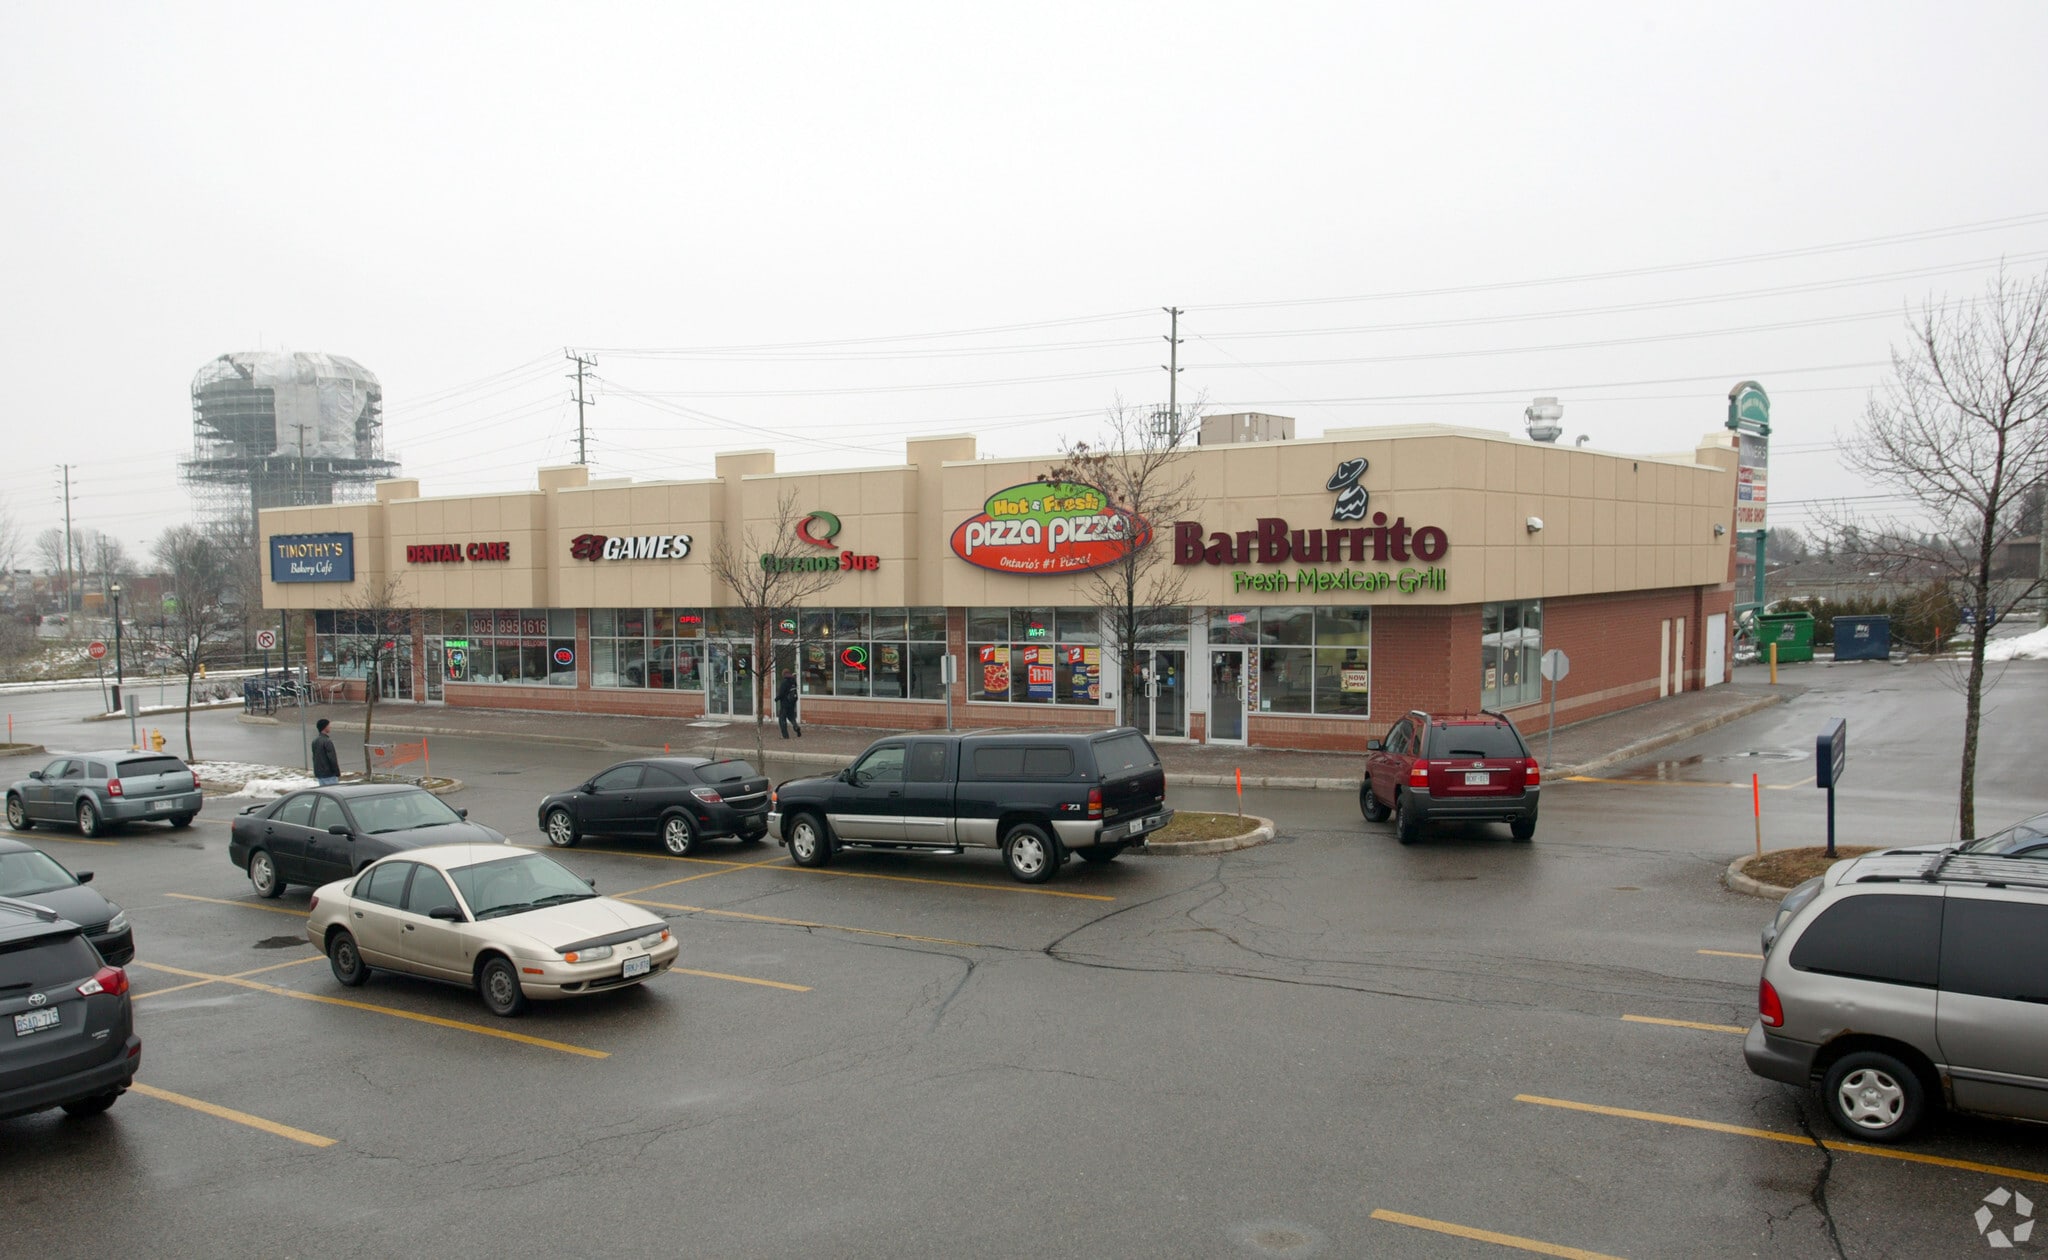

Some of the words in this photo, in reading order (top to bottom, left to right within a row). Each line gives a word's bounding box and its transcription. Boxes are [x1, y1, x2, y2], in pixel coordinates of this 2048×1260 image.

[994, 499, 1030, 516] Hot
[1031, 501, 1041, 511] &
[1042, 492, 1099, 513] Fresh
[1172, 511, 1449, 565] BarBurrito
[278, 543, 343, 558] TIMOTHY'S
[407, 544, 464, 563] DENTAL
[466, 542, 509, 562] CARE
[603, 535, 692, 560] GAMES
[290, 561, 315, 576] Bakery
[315, 560, 333, 576] Café
[1000, 556, 1040, 570] Ontario's
[1043, 558, 1055, 569] #1
[1232, 569, 1289, 593] Fresh
[1295, 567, 1391, 593] Mexican
[1396, 566, 1447, 593] Grill
[473, 618, 492, 633] 905
[499, 618, 519, 633] 895
[522, 619, 547, 634] 1616
[680, 616, 702, 624] OPEN
[90, 646, 105, 655] STOP
